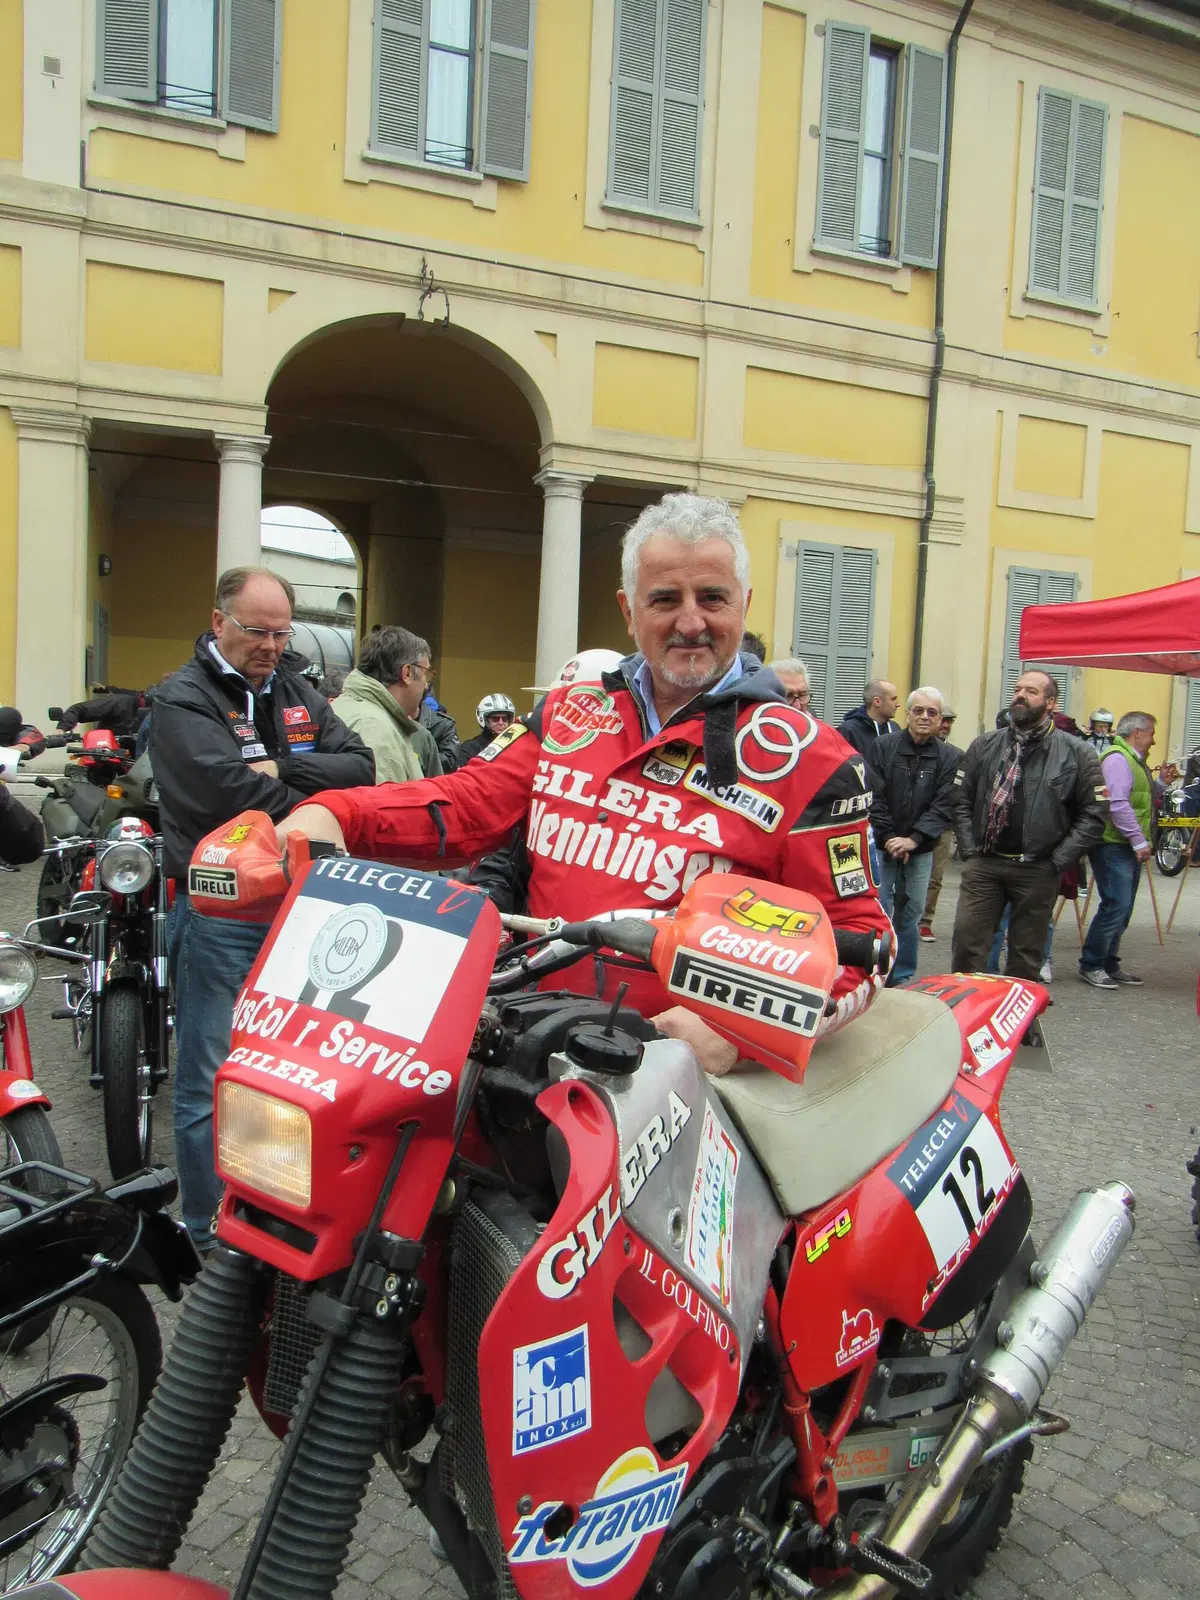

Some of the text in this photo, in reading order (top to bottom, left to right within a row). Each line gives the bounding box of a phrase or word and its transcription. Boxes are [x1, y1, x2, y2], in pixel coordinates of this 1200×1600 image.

[646, 760, 680, 784] Agip
[690, 769, 778, 826] MCHELIN
[190, 868, 236, 896] PIRELLI
[201, 843, 237, 865] Castrol
[316, 858, 432, 900] TELECEL
[840, 873, 867, 892] Agip
[721, 888, 822, 938] UFO
[312, 954, 321, 975] MOTO
[325, 978, 340, 986] 1970
[348, 966, 365, 982] 2015
[335, 936, 359, 957] GILERA
[700, 925, 812, 975] Castrol
[670, 951, 824, 1032] PIRELLI
[990, 982, 1036, 1042] PIRELLI
[226, 1046, 338, 1103] GILERA
[319, 1020, 452, 1096] Service
[900, 1115, 957, 1192] TELECEL
[536, 1090, 693, 1300] GILERA
[697, 1155, 715, 1275] TELECEL
[711, 1163, 721, 1233] 1000
[941, 1145, 997, 1237] 12
[975, 1162, 1020, 1237] VALVE
[805, 1207, 852, 1264] UFO
[639, 1249, 730, 1351] IL GOLFINO
[519, 1419, 569, 1446] INOX
